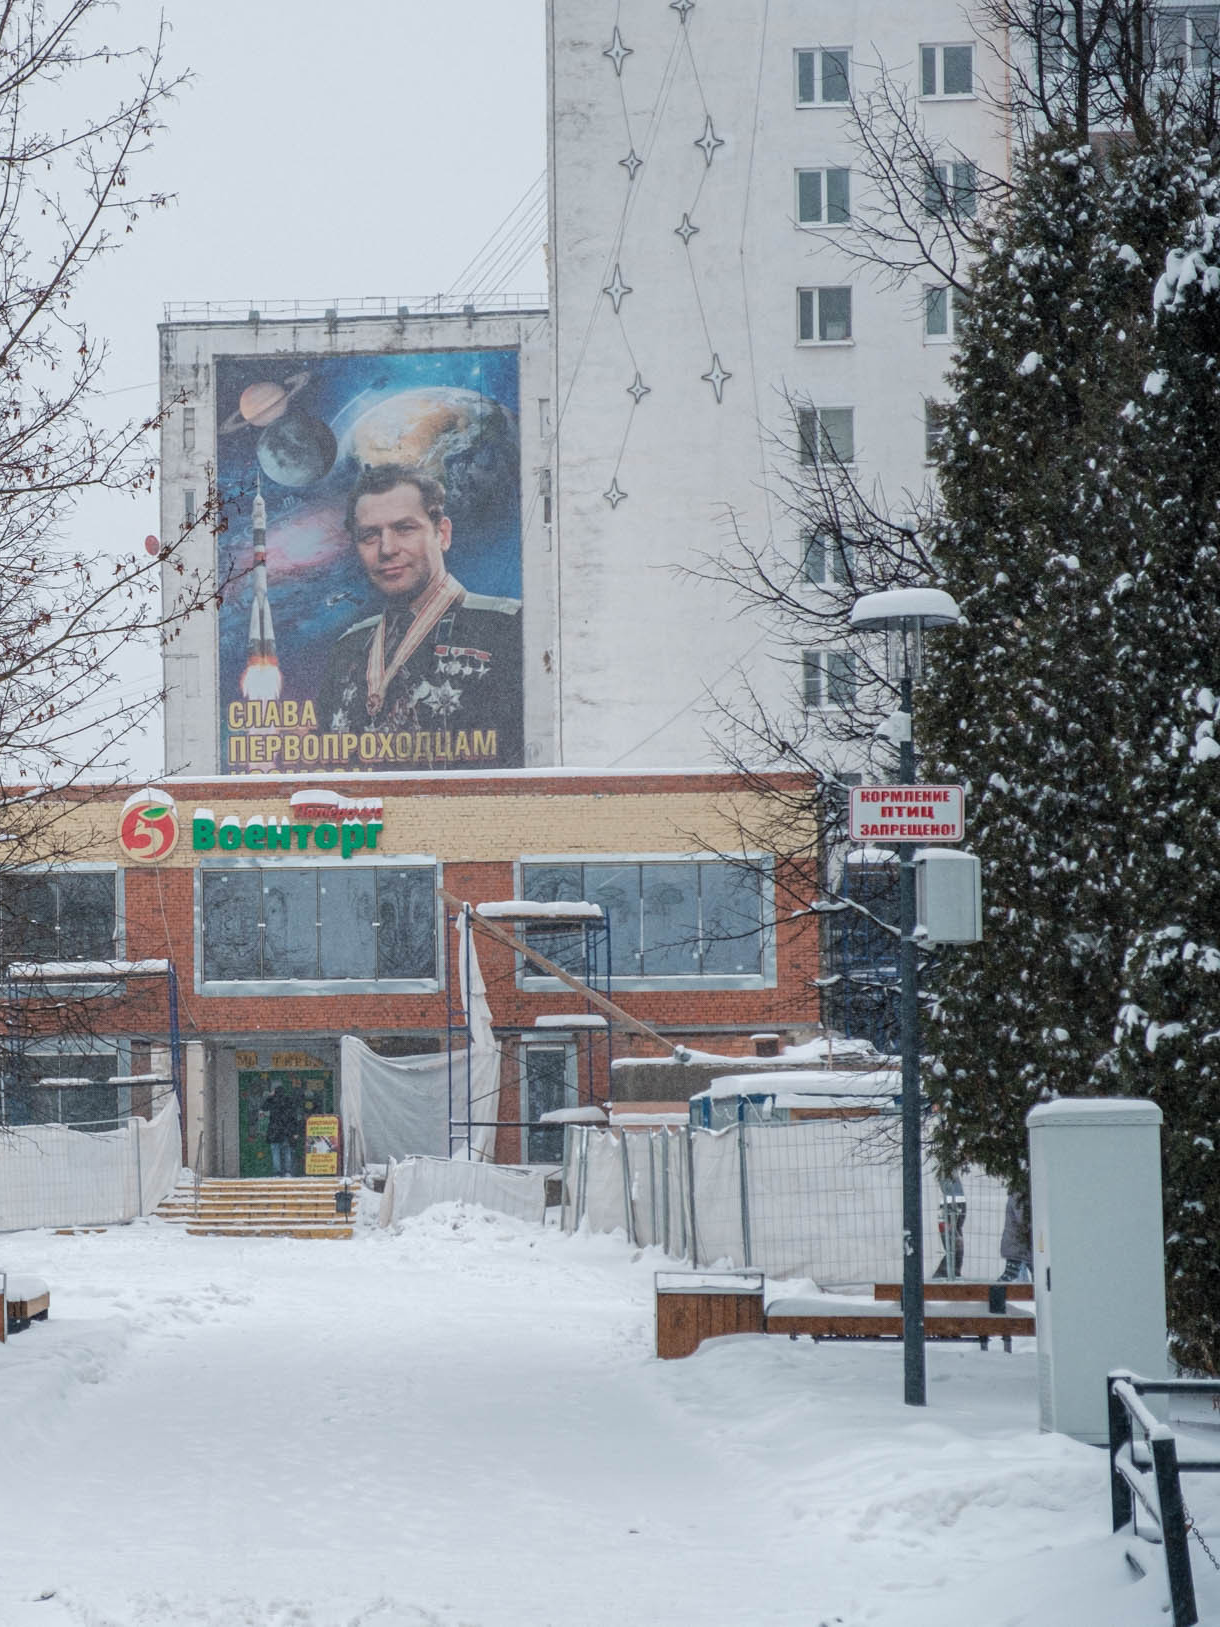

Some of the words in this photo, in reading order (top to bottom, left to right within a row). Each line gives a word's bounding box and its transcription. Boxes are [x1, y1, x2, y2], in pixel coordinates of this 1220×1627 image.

[228, 699, 318, 730] СЛАВА
[228, 730, 497, 763] ПЕРВОПРОХОДЦАМ
[860, 791, 951, 803] КОРМЛЕНИЕ
[881, 806, 935, 819] ПТИЦ
[192, 818, 384, 860] Военторг
[860, 824, 956, 836] ЗАПРЕЩЕНО!
